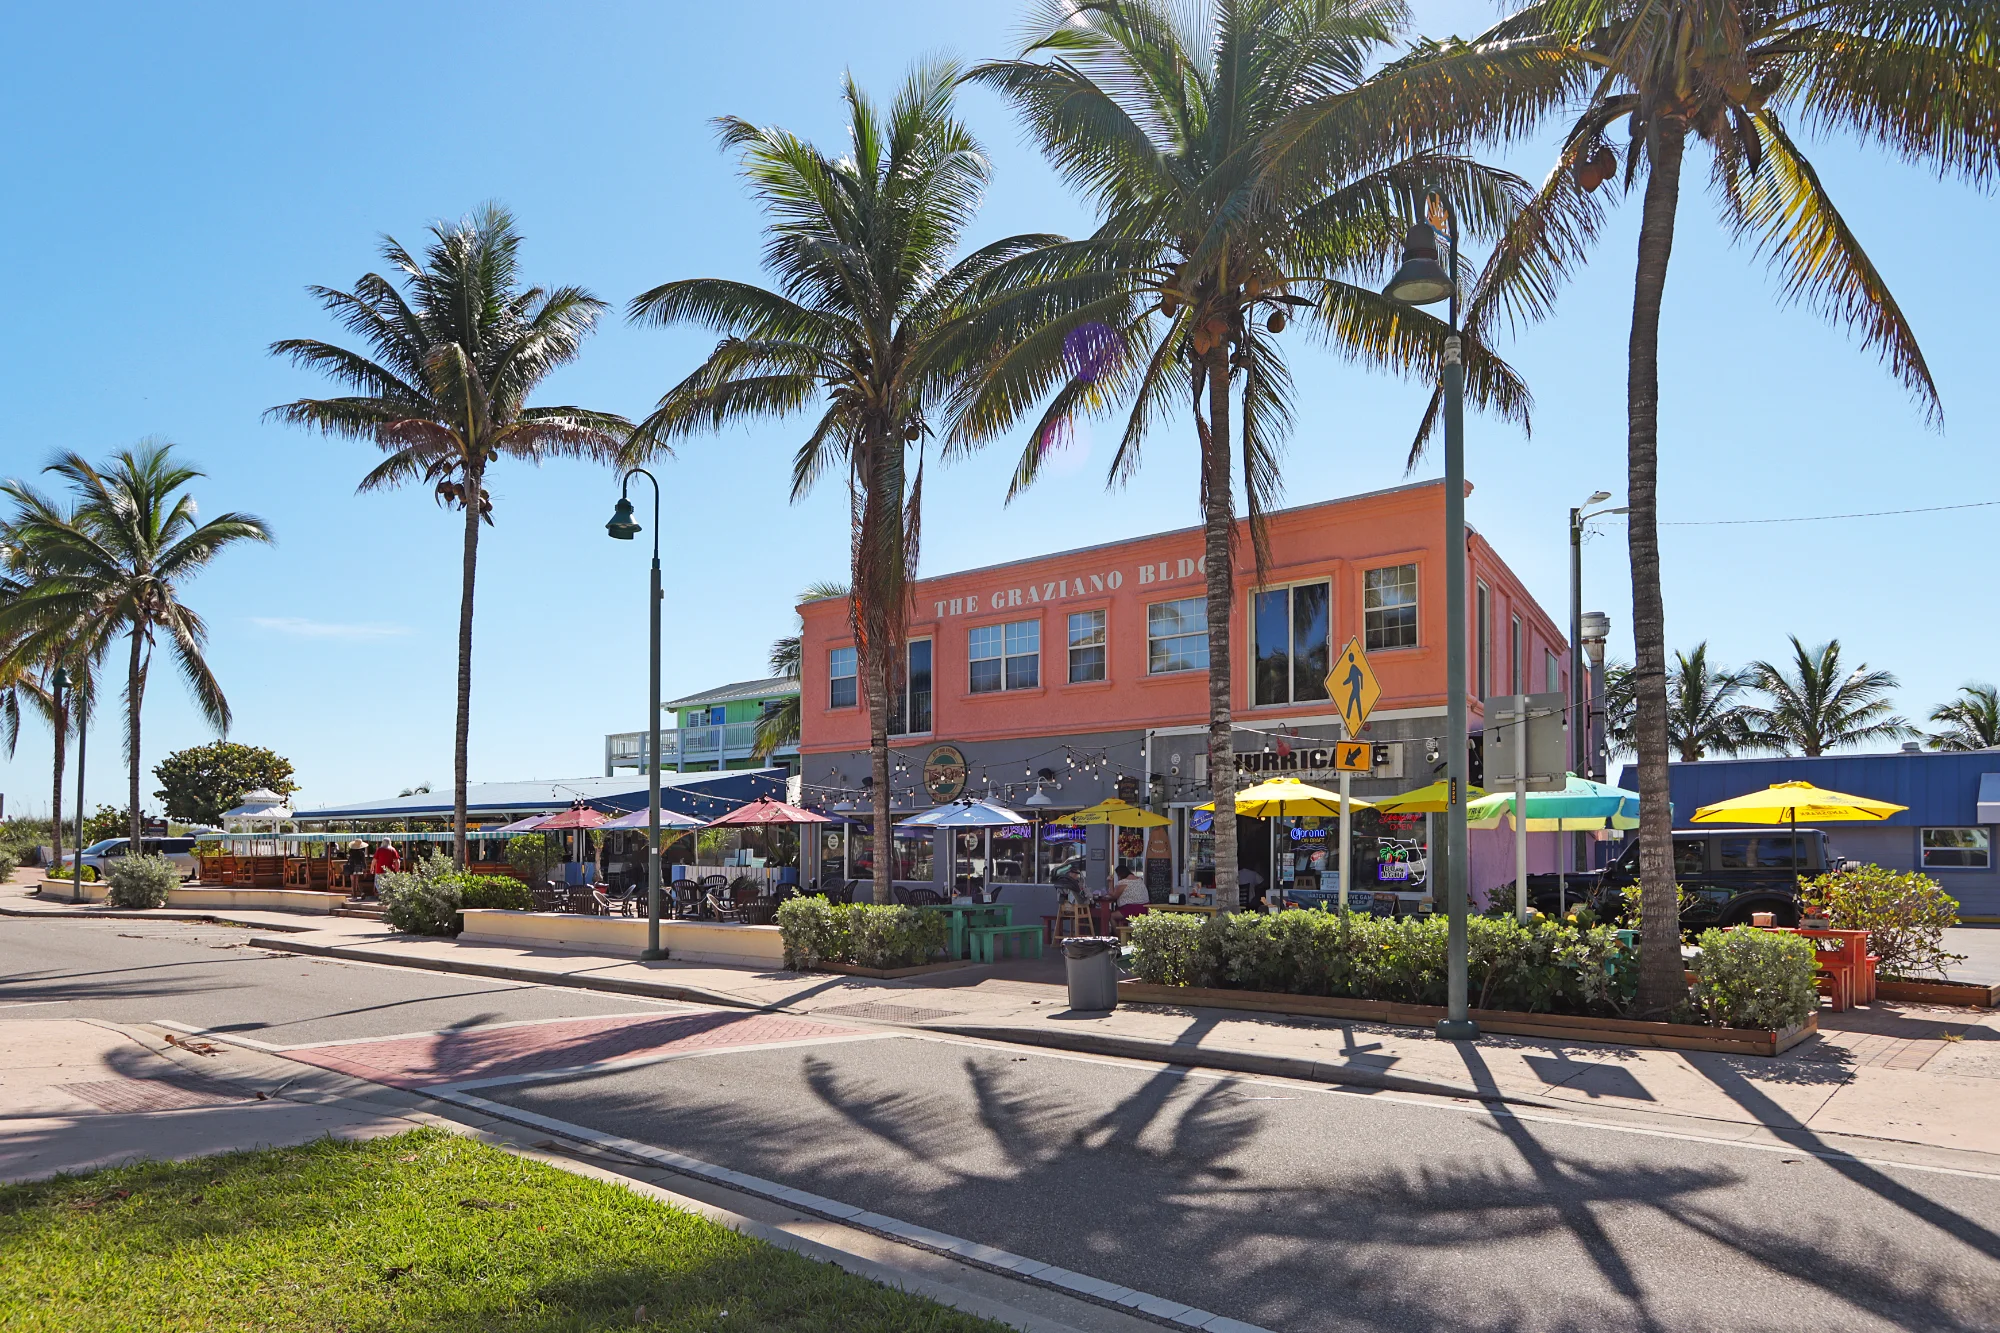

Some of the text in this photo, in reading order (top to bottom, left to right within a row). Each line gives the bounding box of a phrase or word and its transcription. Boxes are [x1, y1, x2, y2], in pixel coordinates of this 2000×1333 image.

[934, 595, 979, 618] THE
[991, 570, 1123, 610] GRAZIANO
[1233, 745, 1390, 773] HURRICE
[1291, 827, 1326, 841] Corona
[1390, 823, 1413, 831] OPEN
